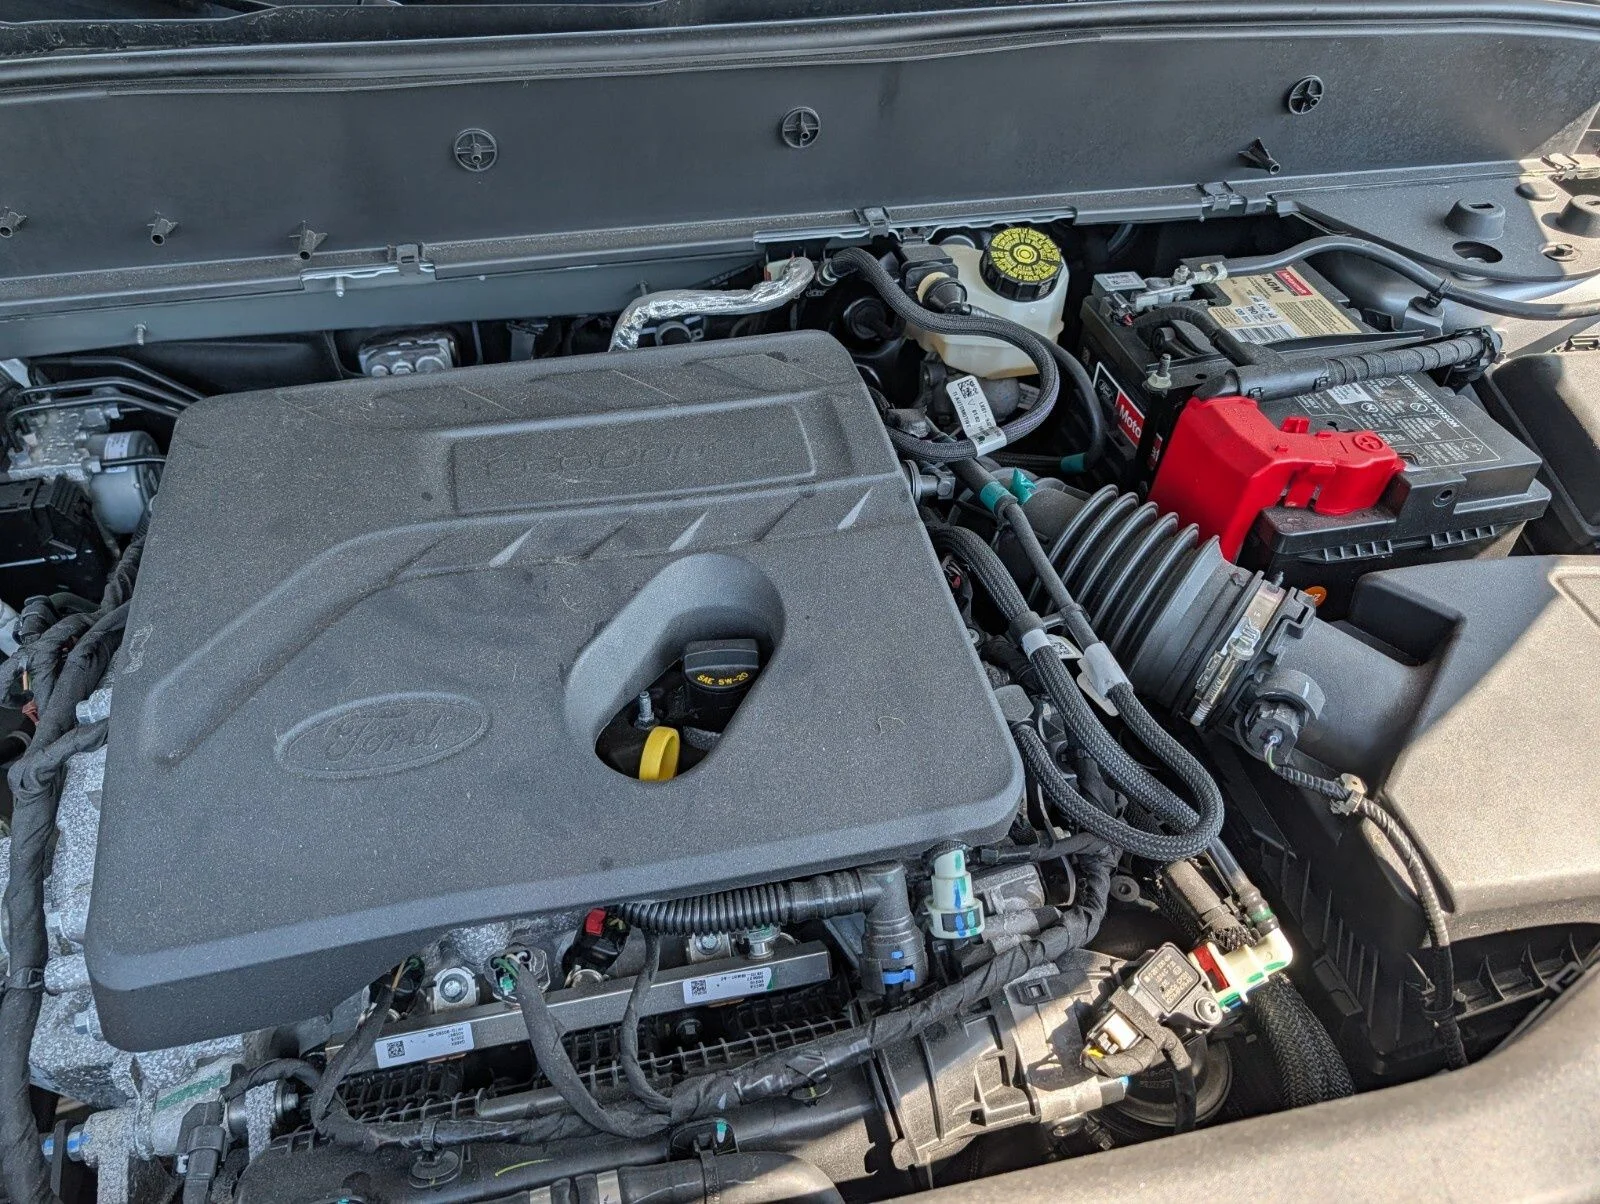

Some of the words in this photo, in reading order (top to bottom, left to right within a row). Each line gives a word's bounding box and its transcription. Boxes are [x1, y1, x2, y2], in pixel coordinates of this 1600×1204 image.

[1262, 277, 1284, 293] AGM
[697, 674, 715, 685] SAE
[718, 672, 749, 686] 5W-20
[323, 708, 452, 763] Ford
